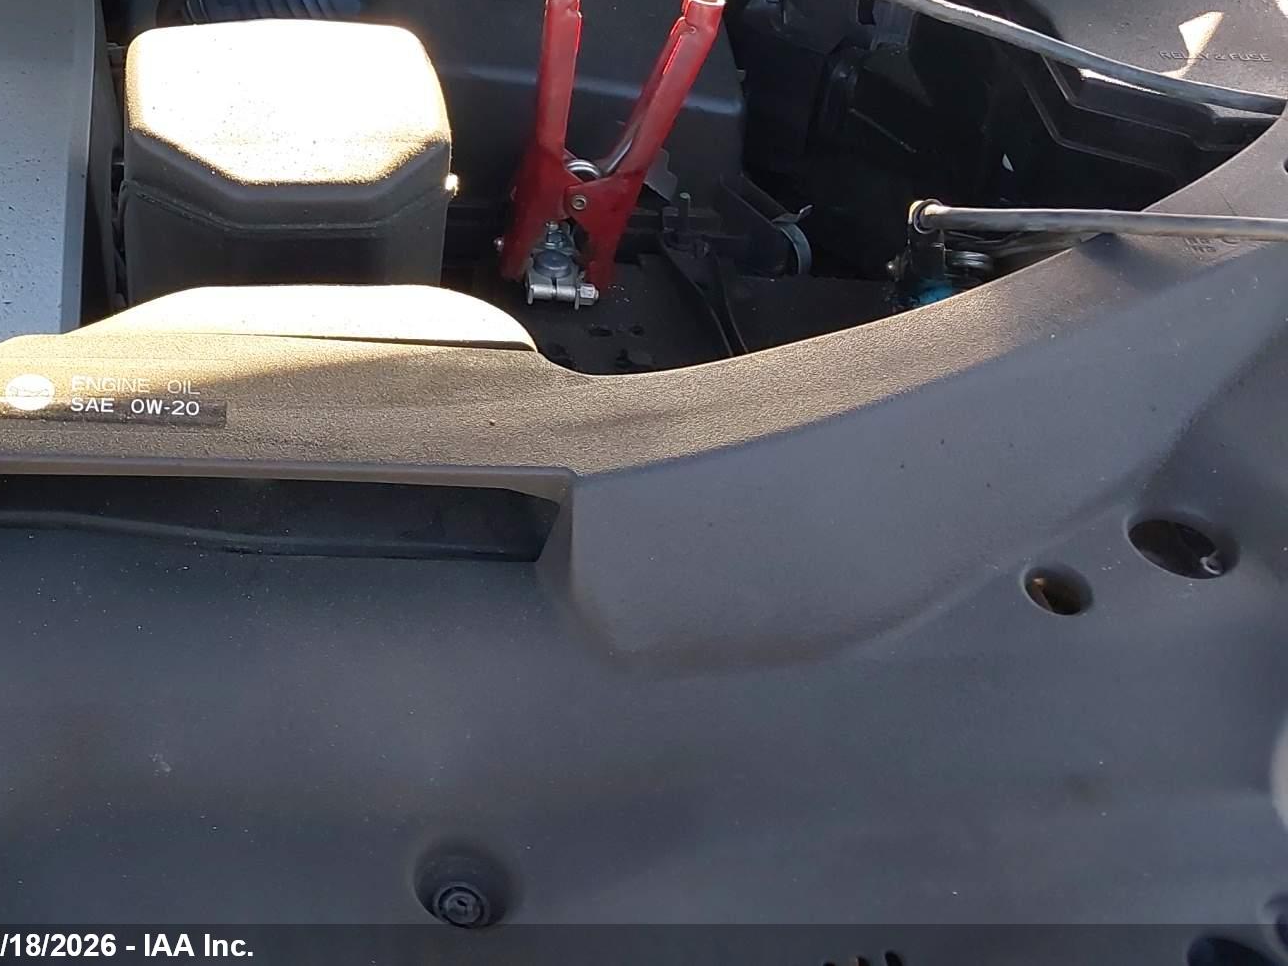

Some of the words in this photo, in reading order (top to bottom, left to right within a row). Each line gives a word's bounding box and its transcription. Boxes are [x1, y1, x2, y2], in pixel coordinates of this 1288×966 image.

[1159, 50, 1209, 61] RELY
[1214, 52, 1227, 61] &
[1229, 52, 1273, 62] FUSE
[71, 375, 150, 394] ENGINE
[167, 379, 201, 396] OIL
[70, 397, 115, 413] SAE
[130, 398, 201, 416] 0W-20
